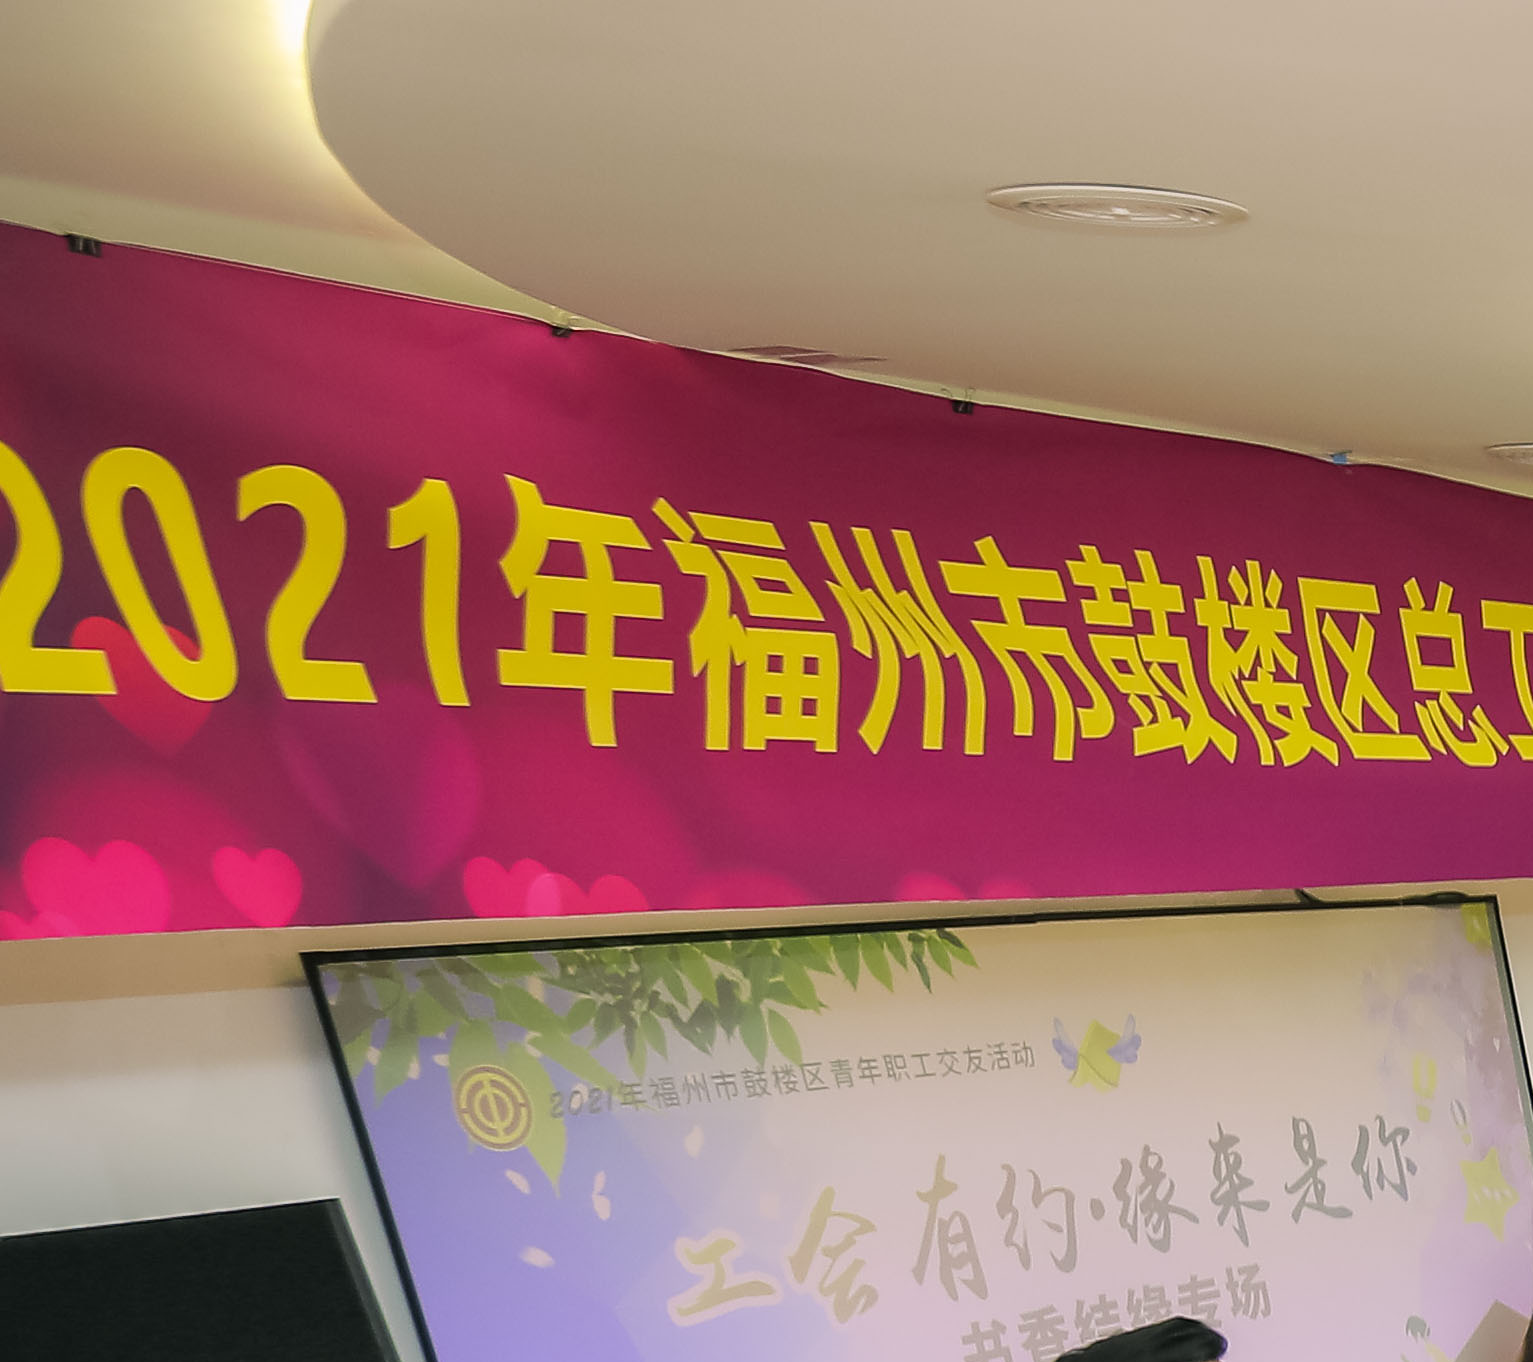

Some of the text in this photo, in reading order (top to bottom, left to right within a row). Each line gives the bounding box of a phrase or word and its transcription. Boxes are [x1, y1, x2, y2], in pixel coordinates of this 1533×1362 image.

[549, 1040, 1035, 1119] 2021年福州市鼓楼区青年职工交友活动
